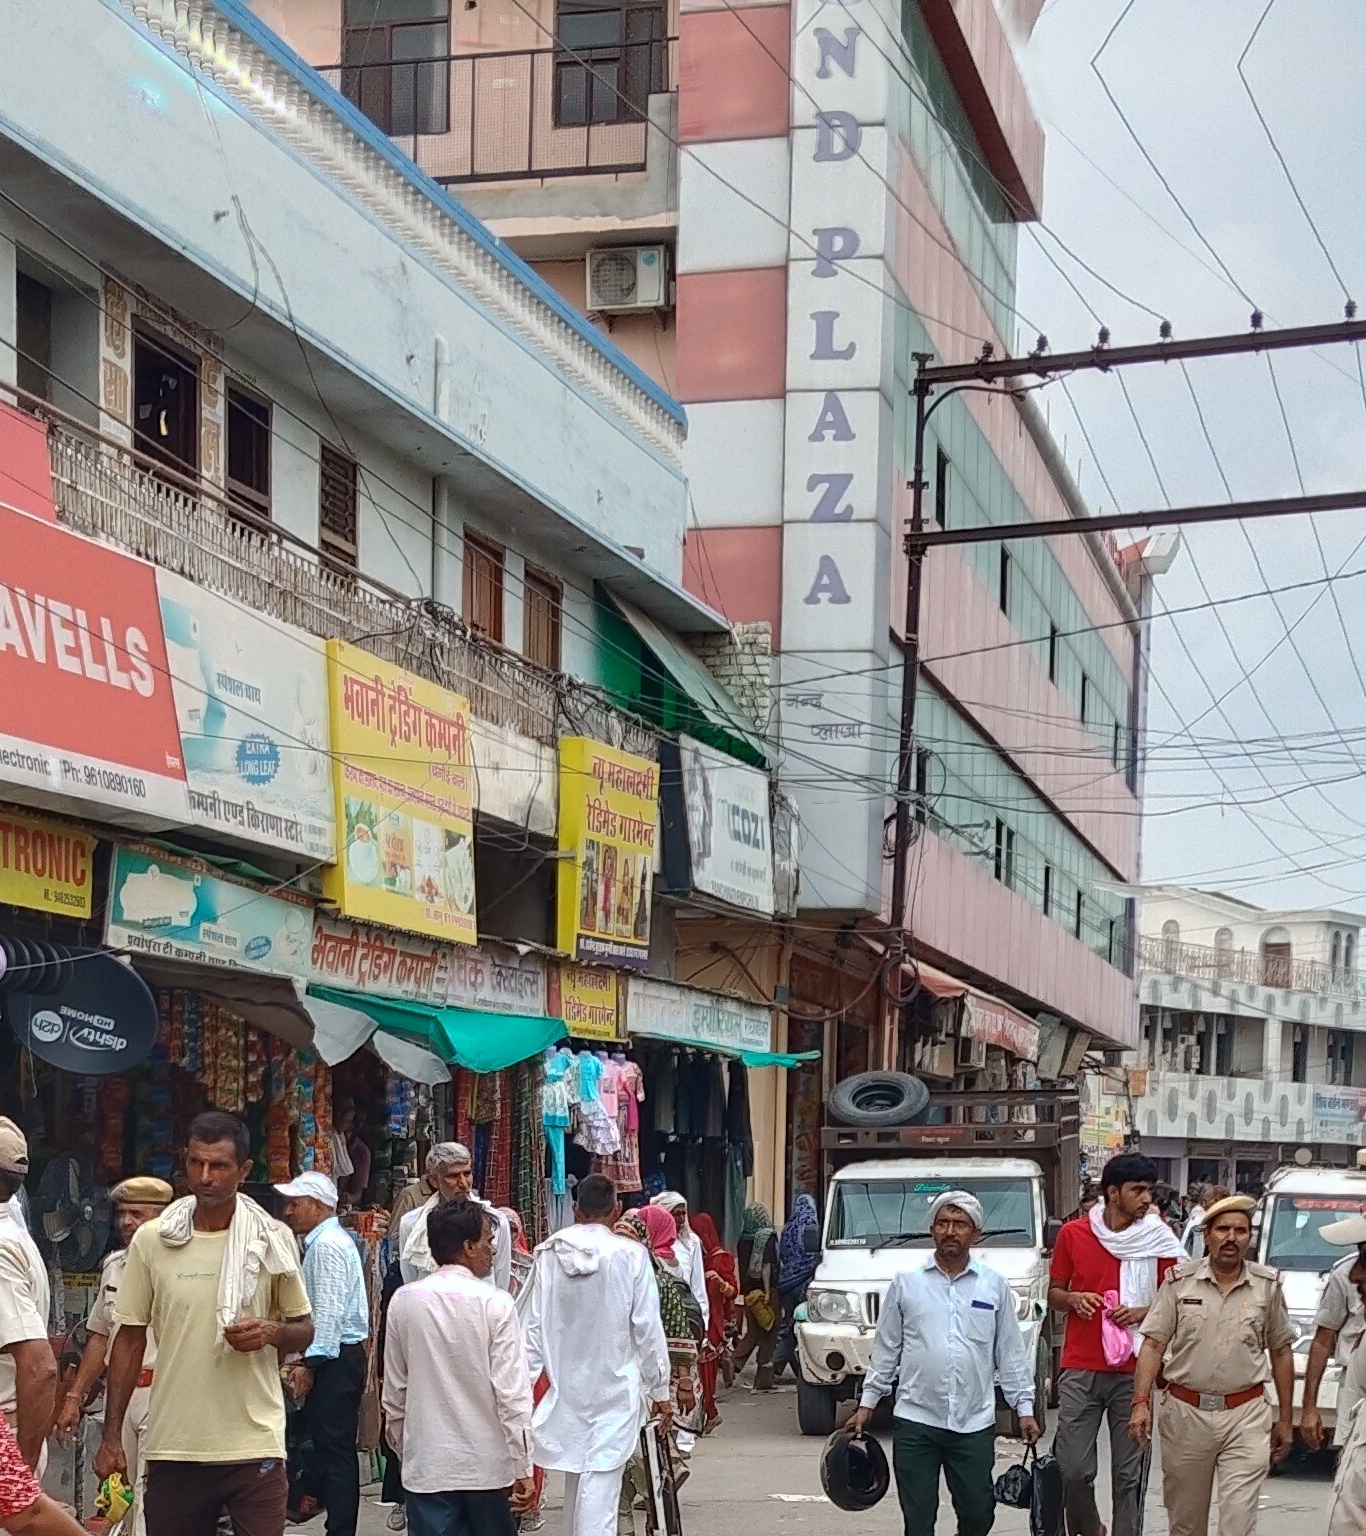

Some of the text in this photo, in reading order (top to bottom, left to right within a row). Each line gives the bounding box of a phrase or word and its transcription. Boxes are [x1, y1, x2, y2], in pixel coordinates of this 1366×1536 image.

[804, 227, 861, 606] PLAZA
[342, 673, 386, 736] भवानी
[423, 706, 467, 766] कम्पनी
[62, 760, 83, 784] Ph:
[83, 762, 147, 799] 9610890160
[238, 756, 258, 776] LONG
[311, 926, 359, 975] भवानी
